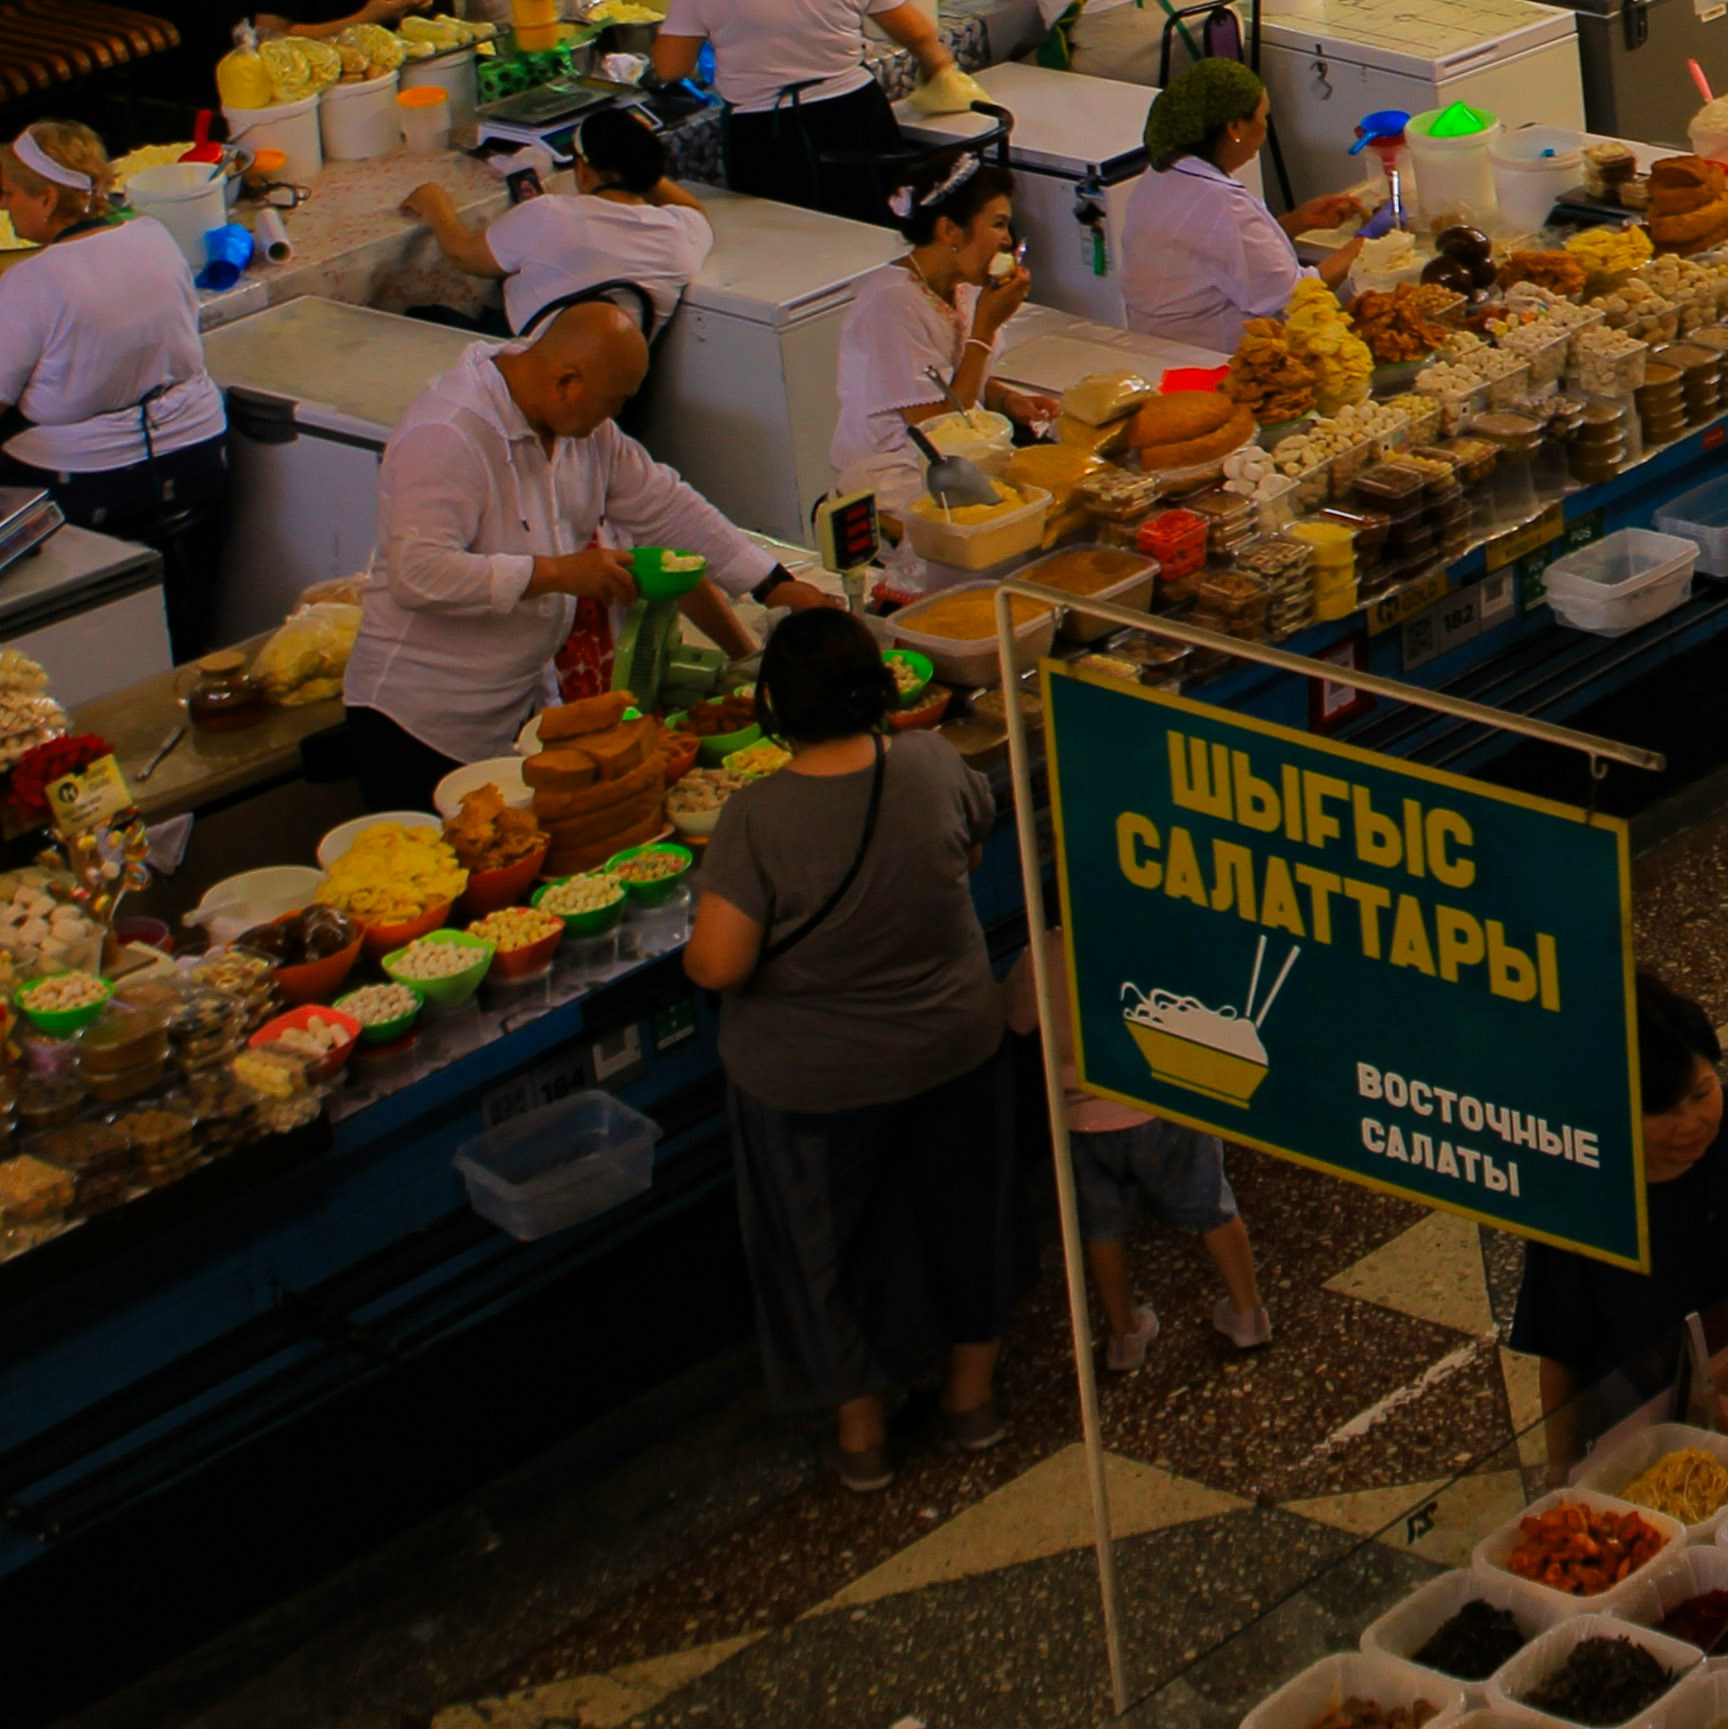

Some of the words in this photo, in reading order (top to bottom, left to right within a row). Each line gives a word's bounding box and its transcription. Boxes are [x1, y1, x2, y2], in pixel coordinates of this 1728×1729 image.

[1444, 603, 1474, 633] 182
[1166, 729, 1477, 889] ШЫҒЫС
[1114, 810, 1562, 1012] САЛАТТАРЫ
[1356, 1061, 1601, 1169] ВОСТОЧНЫЕ
[1360, 1117, 1521, 1197] САЛАТЫ
